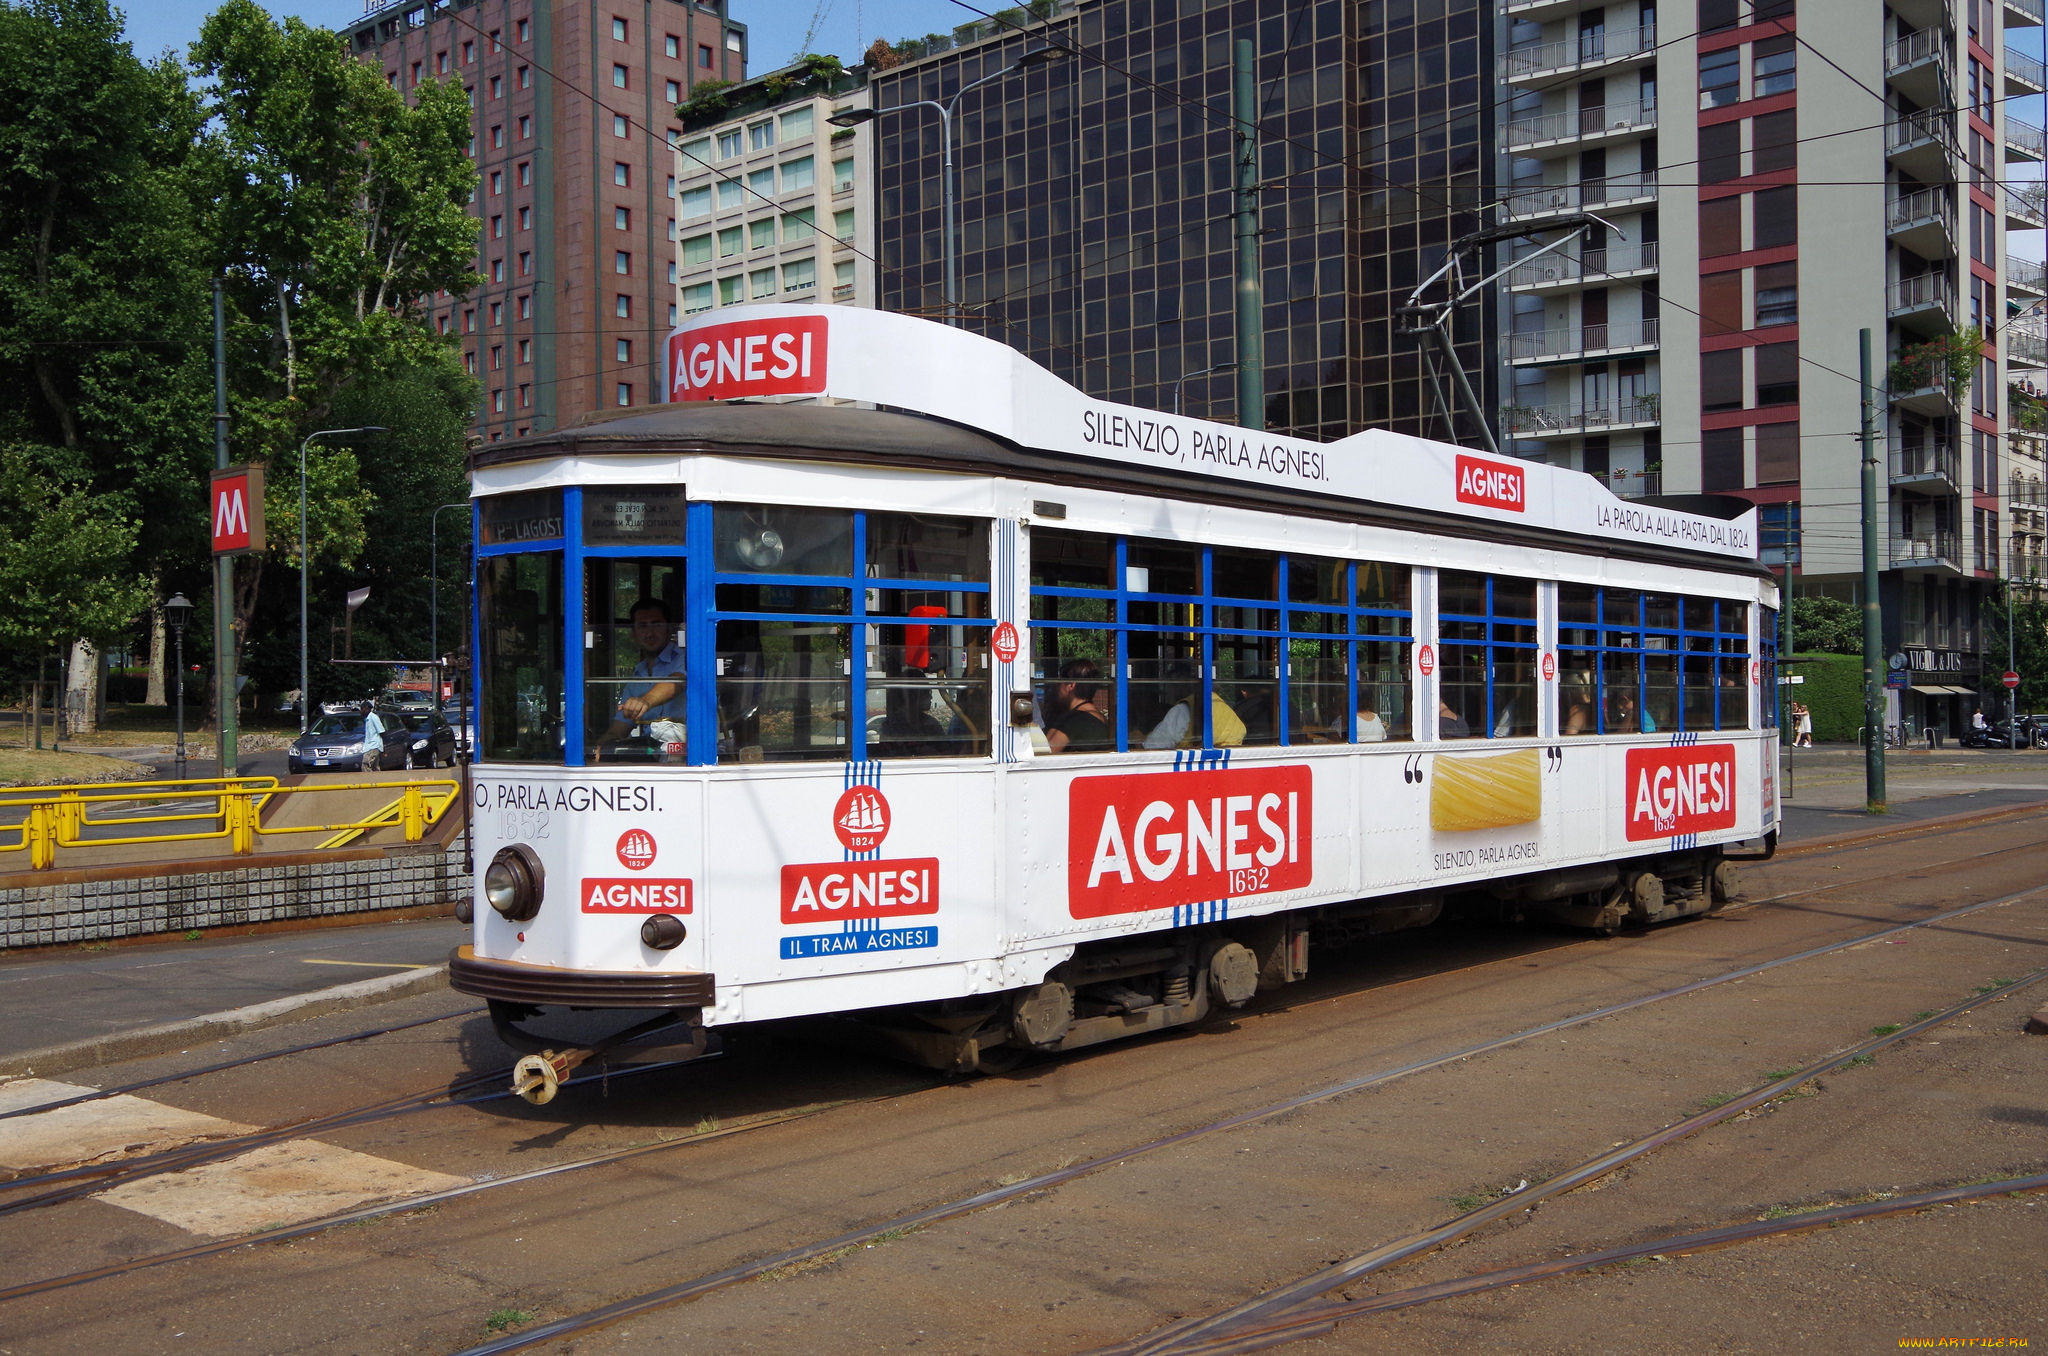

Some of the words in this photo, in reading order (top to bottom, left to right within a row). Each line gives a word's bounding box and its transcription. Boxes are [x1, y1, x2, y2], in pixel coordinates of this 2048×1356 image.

[673, 332, 812, 393] AGNESI
[1083, 410, 1186, 463] SILENZIO,
[1193, 430, 1252, 469] PARLA
[1257, 443, 1329, 482] AGNESI.
[1460, 465, 1521, 503] AGNESI
[215, 488, 248, 538] M
[1597, 504, 1612, 527] LA
[1614, 508, 1652, 533] PAROLA
[1655, 514, 1678, 538] ALLA
[1681, 518, 1707, 542] PASTA
[1710, 523, 1726, 546] DAL
[1729, 526, 1749, 548] 1824
[1946, 652, 1961, 671] JUS
[498, 784, 549, 810] PARLA
[554, 786, 663, 812] AGNESI.
[1633, 761, 1730, 822] AGNESI
[497, 811, 550, 839] 1652
[1654, 814, 1676, 832] 1652
[851, 836, 874, 846] 1824
[1087, 791, 1298, 888] AGNESI
[1434, 850, 1477, 871] SILENZIO,
[1479, 846, 1505, 865] PARLA
[1507, 842, 1541, 860] AGNESI.
[791, 869, 929, 912] AGNESI
[1228, 866, 1270, 893] 1652
[588, 885, 686, 908] AGNESI
[790, 940, 803, 955] IL
[812, 935, 857, 953] TRAM
[867, 930, 928, 949] AGNESI
